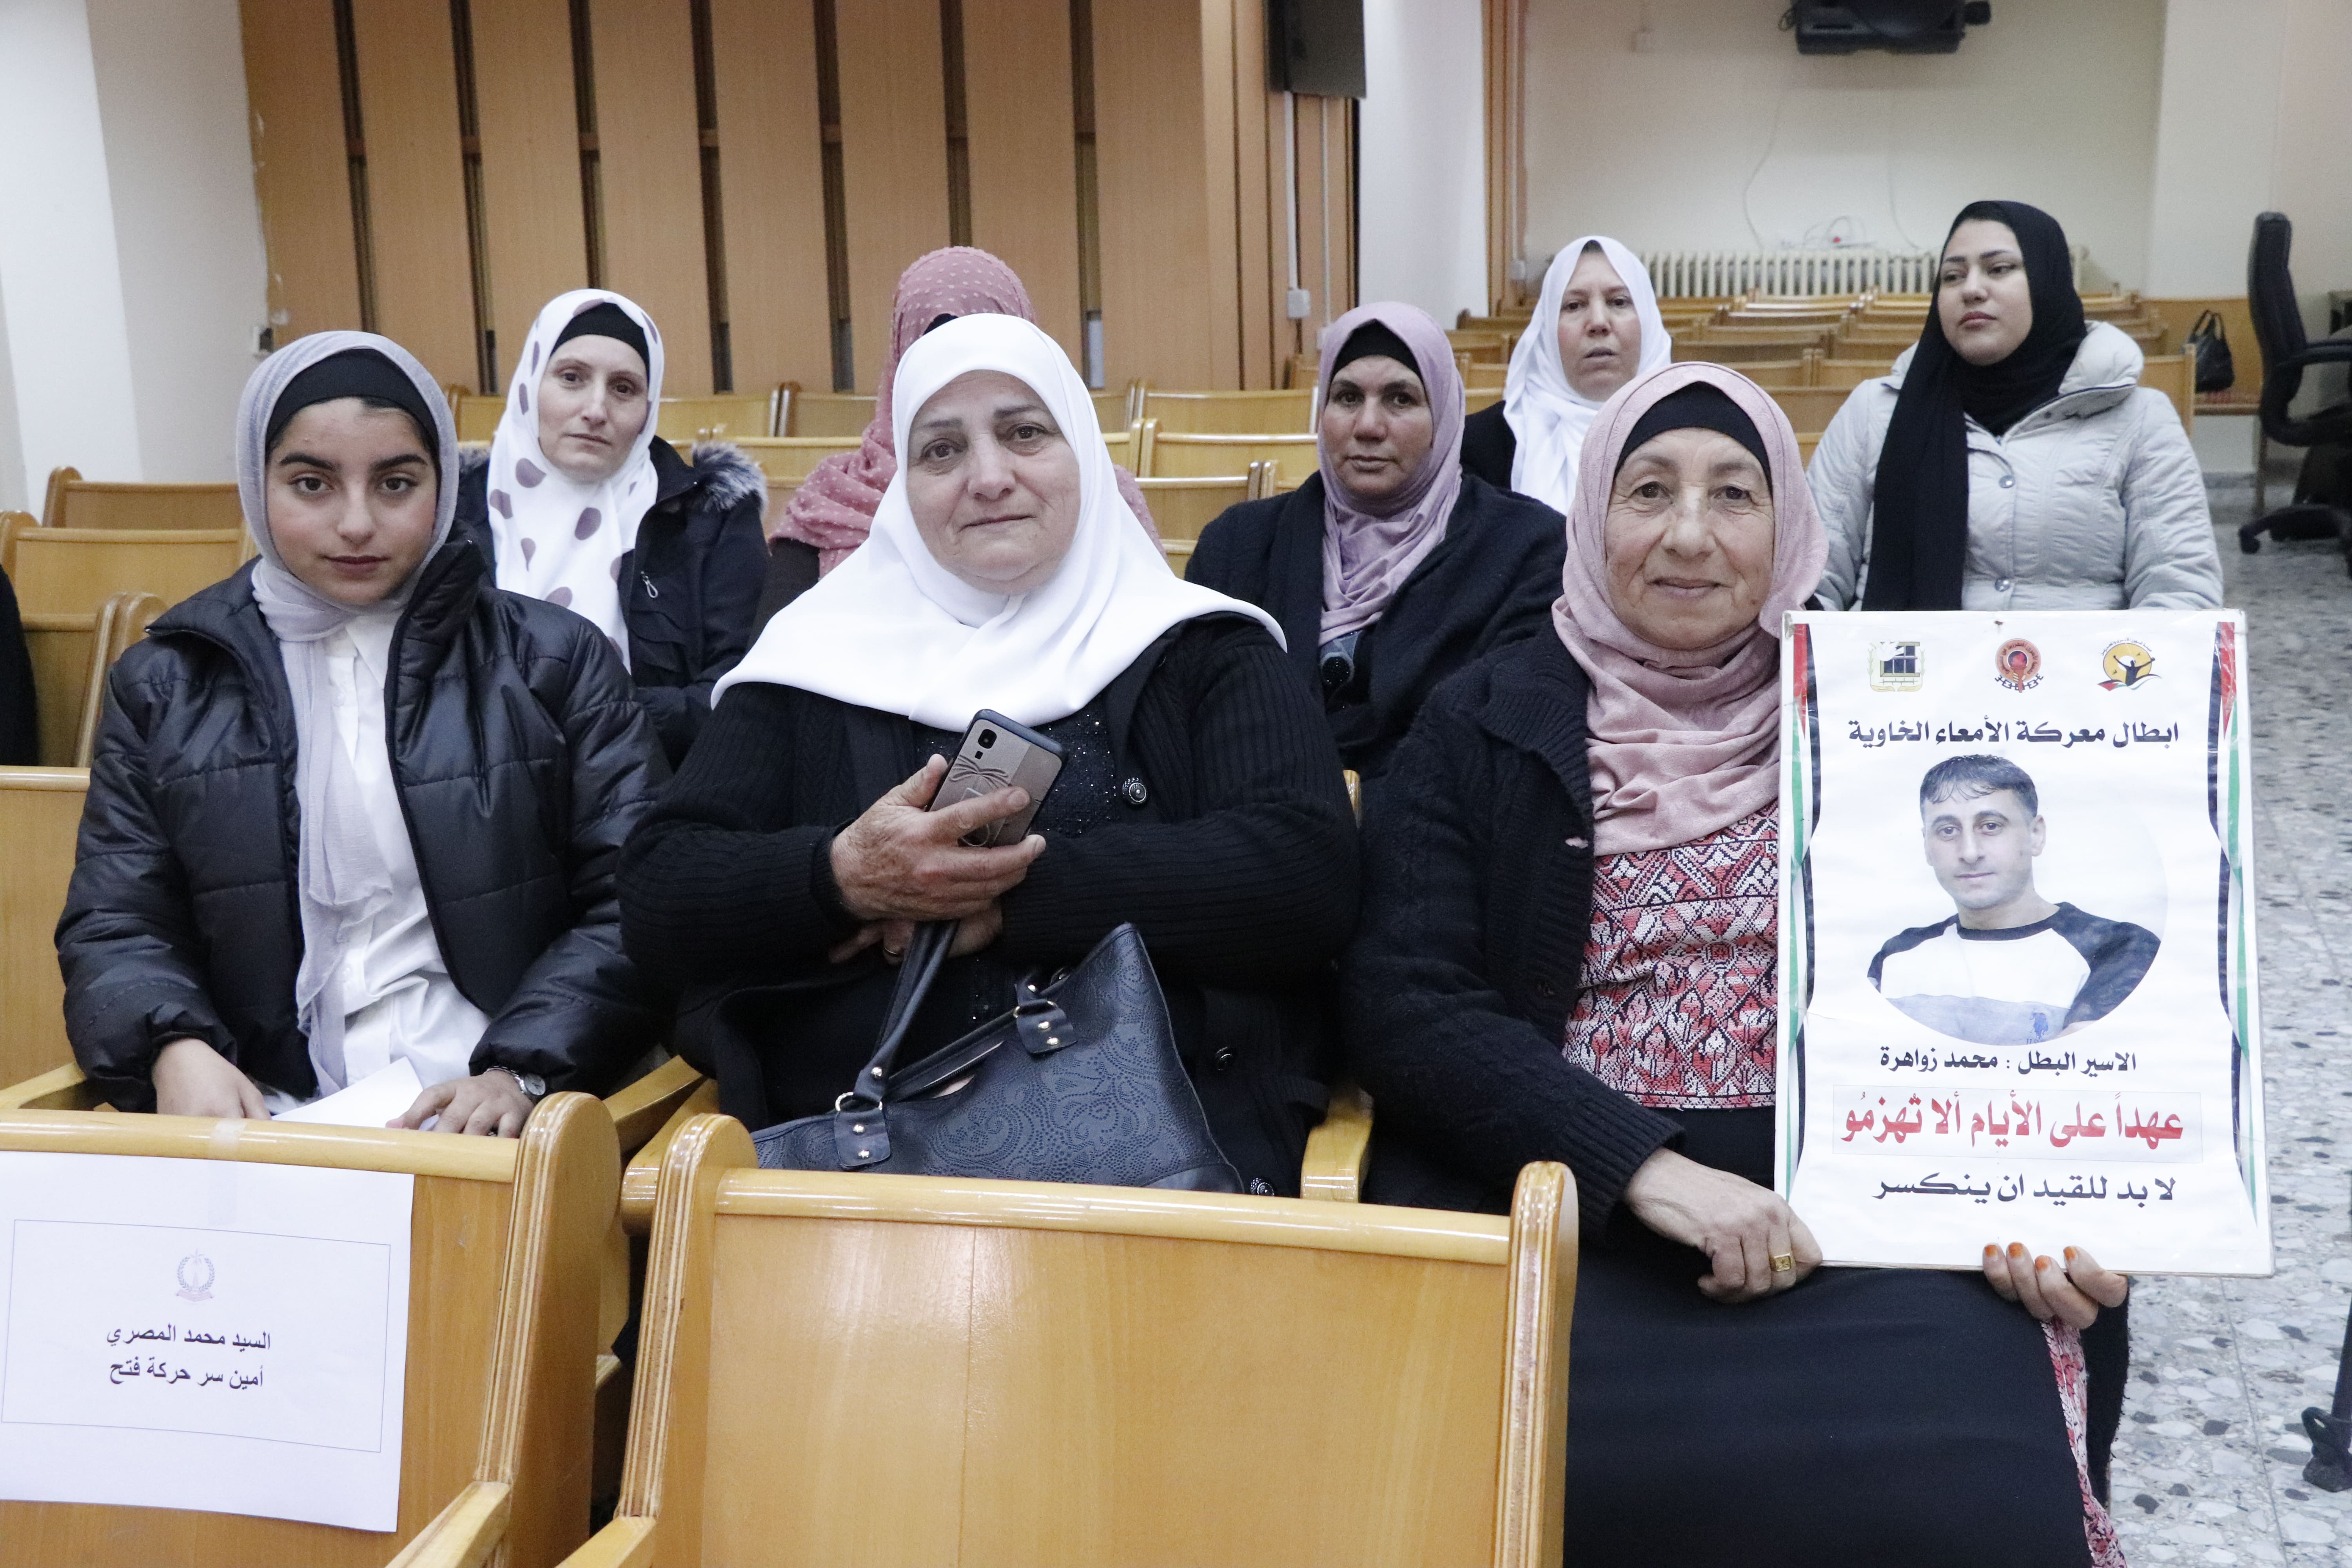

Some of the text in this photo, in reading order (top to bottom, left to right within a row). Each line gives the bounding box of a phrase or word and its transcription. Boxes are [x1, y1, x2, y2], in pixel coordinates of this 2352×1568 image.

[1848, 715, 2178, 750] ابطال معركة الأمعاء الخاوية
[1880, 1047, 1938, 1072] زواهرة
[1944, 1052, 1998, 1069] محمد
[2018, 1051, 2075, 1076] البطل
[2081, 1052, 2136, 1077] الاسير
[1931, 1091, 1960, 1134] ألا
[1971, 1089, 2042, 1147] الأيام
[2050, 1103, 2106, 1148] على
[1872, 1172, 2176, 1208] لا بد للقيد ان ينكسر
[107, 1323, 270, 1352] السيد محمد المصري
[110, 1356, 263, 1390] أمين سر حركة فتح
